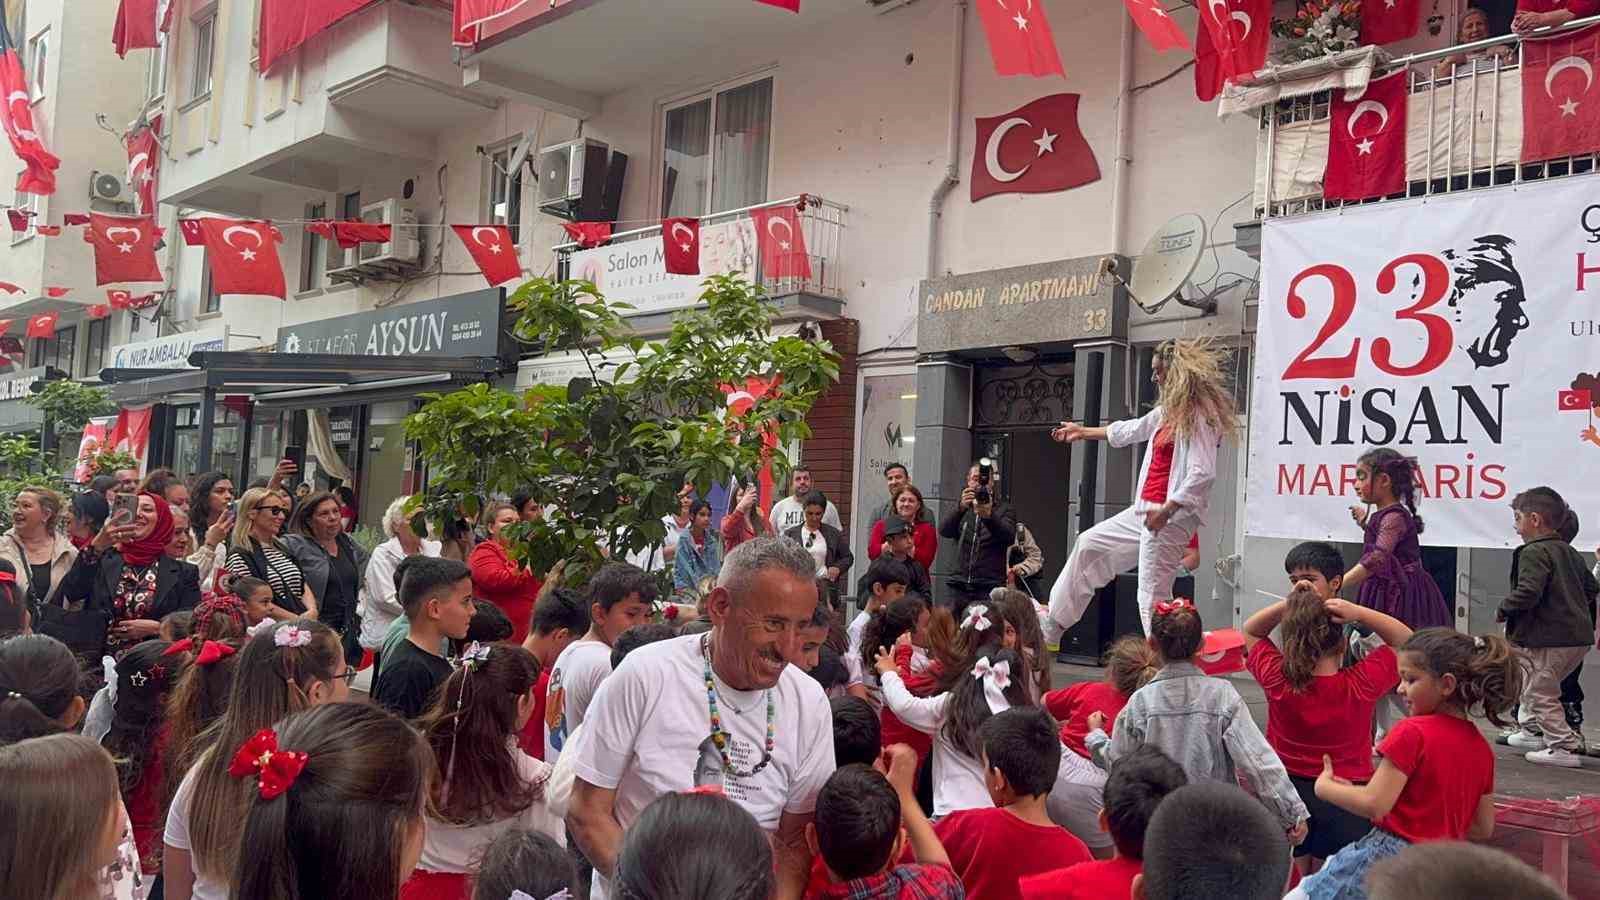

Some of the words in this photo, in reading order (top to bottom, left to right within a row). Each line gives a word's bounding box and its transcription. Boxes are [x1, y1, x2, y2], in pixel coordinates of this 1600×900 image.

[1580, 204, 1600, 243] Ç
[607, 251, 648, 273] Salon
[1576, 252, 1600, 291] H
[925, 286, 986, 314] CANDAN
[1281, 252, 1455, 381] 23
[364, 311, 448, 356] AYSUN
[1083, 308, 1107, 332] 33
[1570, 320, 1600, 337] Ul
[129, 349, 147, 367] NUR
[149, 340, 192, 363] AMBALAJ
[1278, 383, 1510, 446] NİSAN
[1277, 452, 1507, 500] MARARİS
[785, 511, 805, 525] MIA
